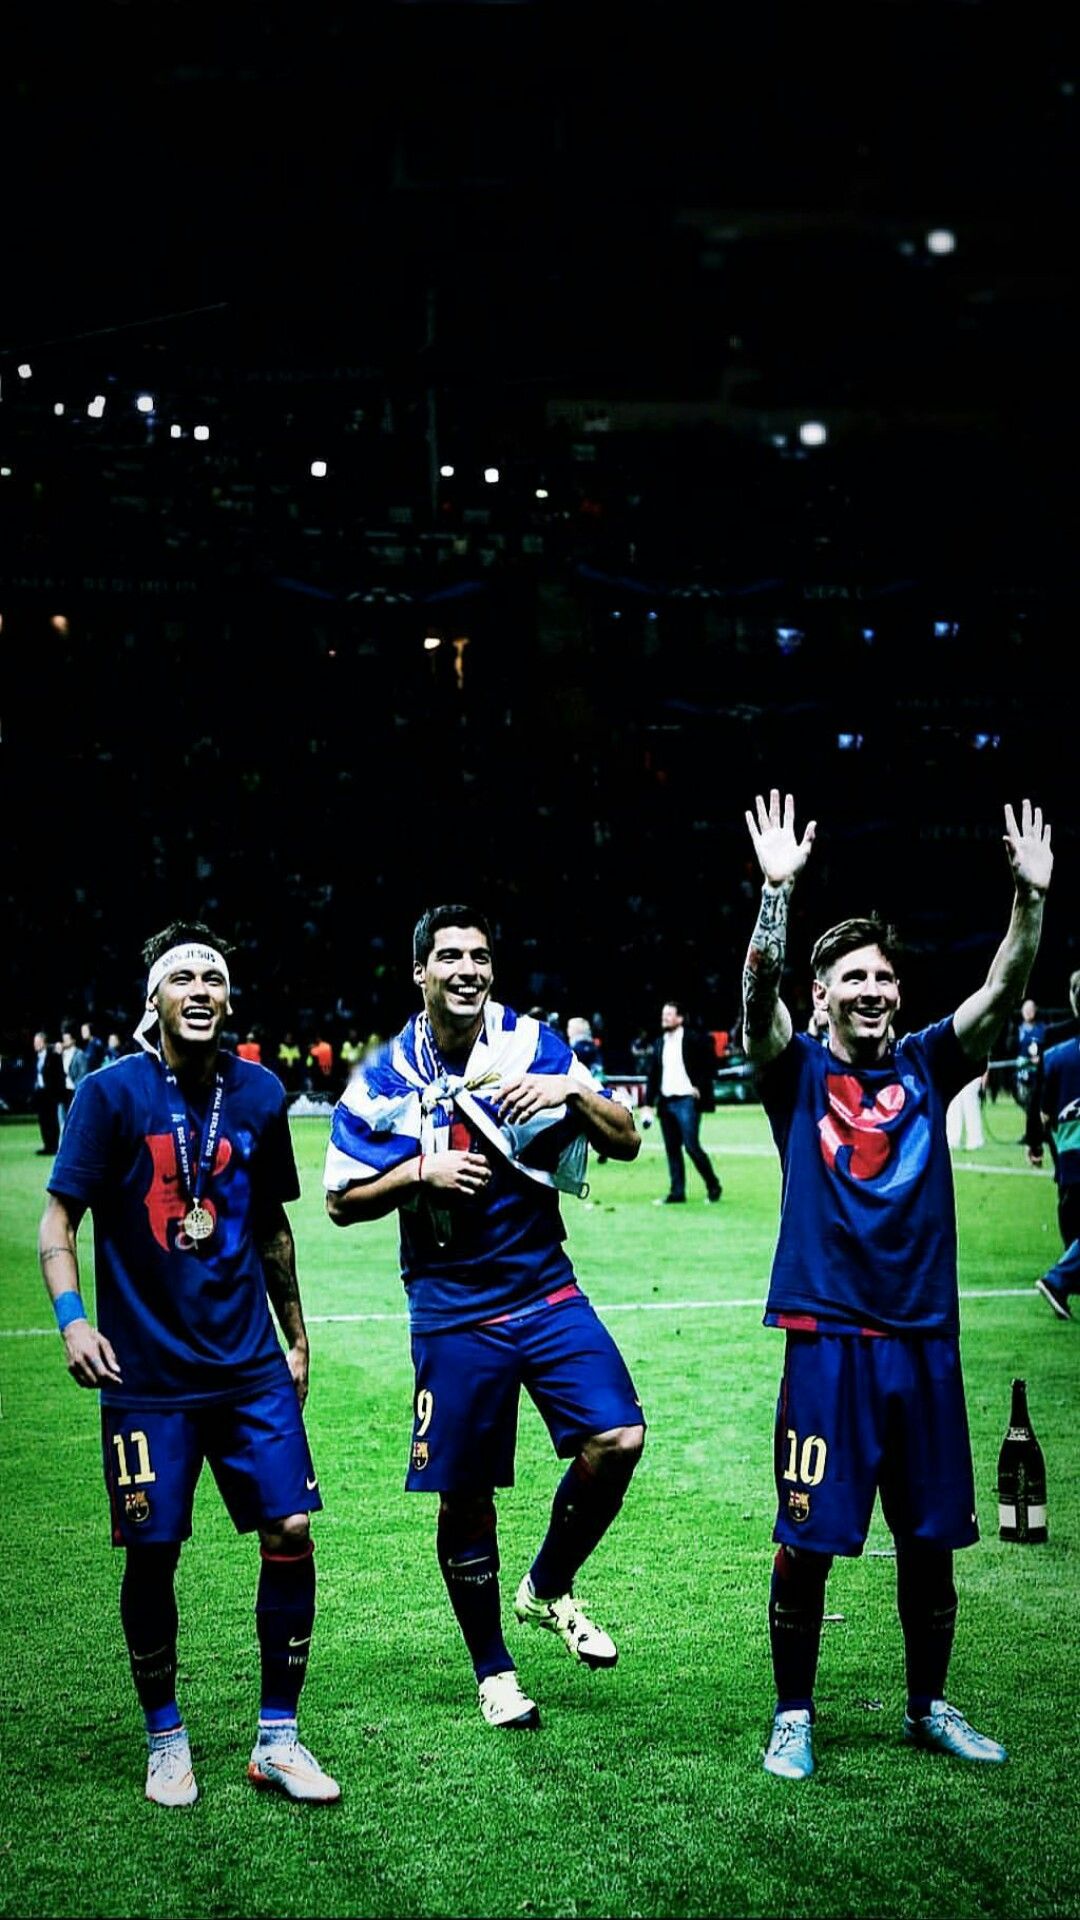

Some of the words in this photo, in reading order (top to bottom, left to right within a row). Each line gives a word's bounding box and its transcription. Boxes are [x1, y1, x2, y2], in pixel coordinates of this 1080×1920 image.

[417, 1388, 433, 1437] 9
[113, 1430, 156, 1486] 11
[783, 1429, 827, 1486] 10
